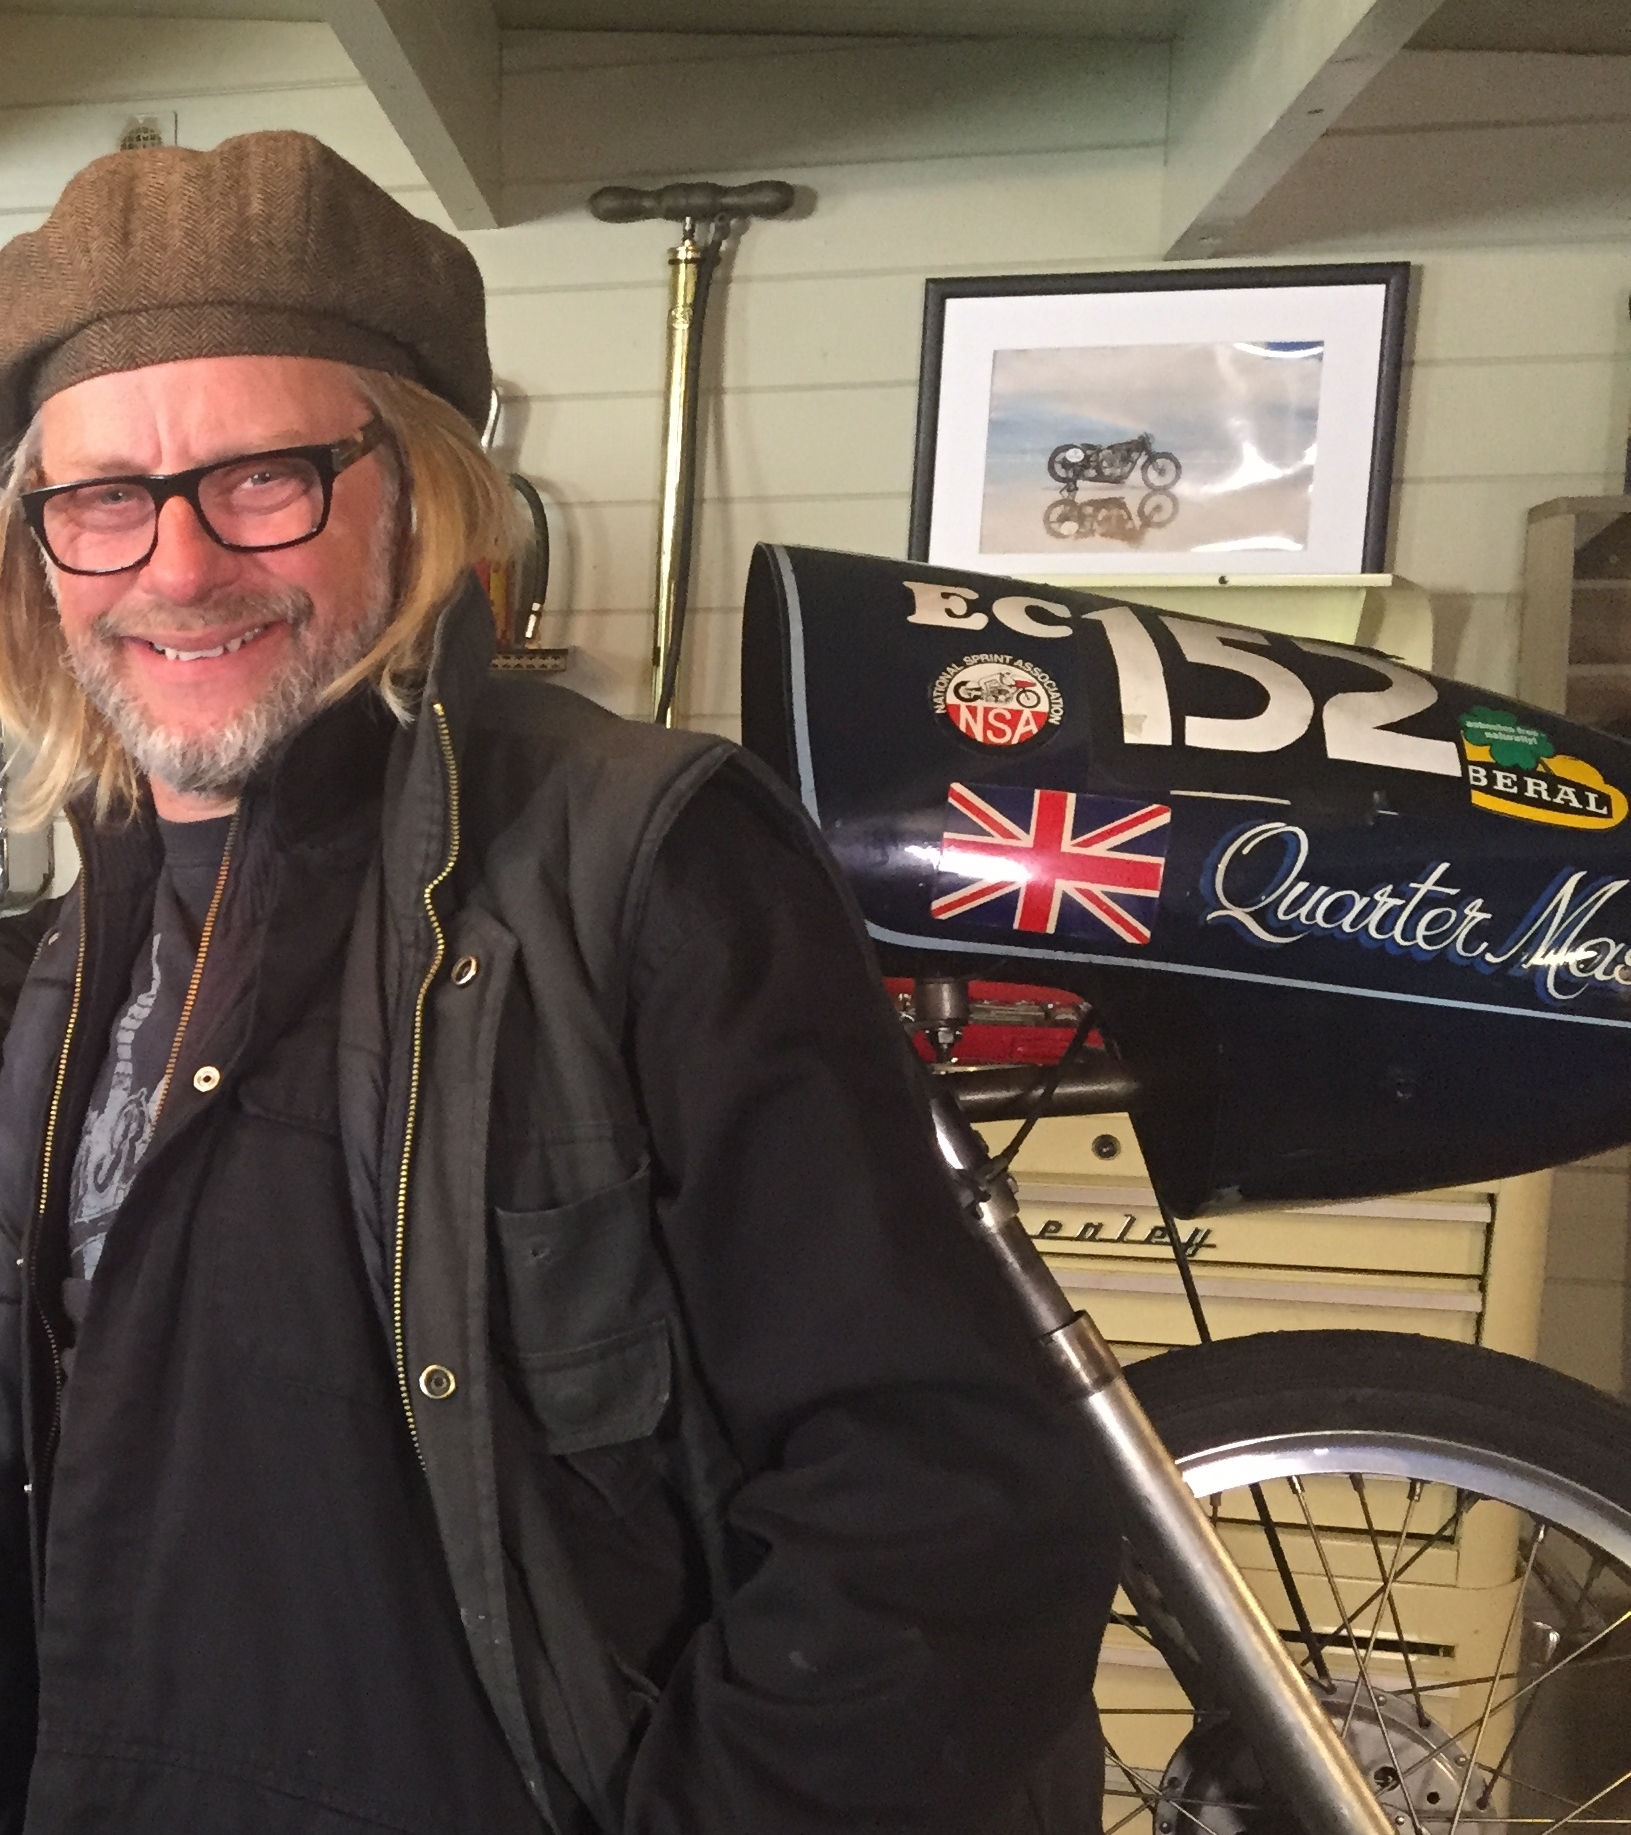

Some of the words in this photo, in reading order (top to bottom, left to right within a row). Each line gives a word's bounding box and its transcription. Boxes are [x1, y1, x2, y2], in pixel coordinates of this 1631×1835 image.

[903, 581, 1074, 639] EC
[1081, 605, 1462, 777] 152
[933, 663, 964, 714] NATIONAL
[963, 653, 1013, 666] SPRINT
[1014, 659, 1065, 725] ASSOCIATION
[959, 703, 1039, 745] NSA
[1468, 765, 1608, 815] BERAL
[1204, 821, 1493, 960] Quarter
[1032, 1213, 1216, 1258] ealey
